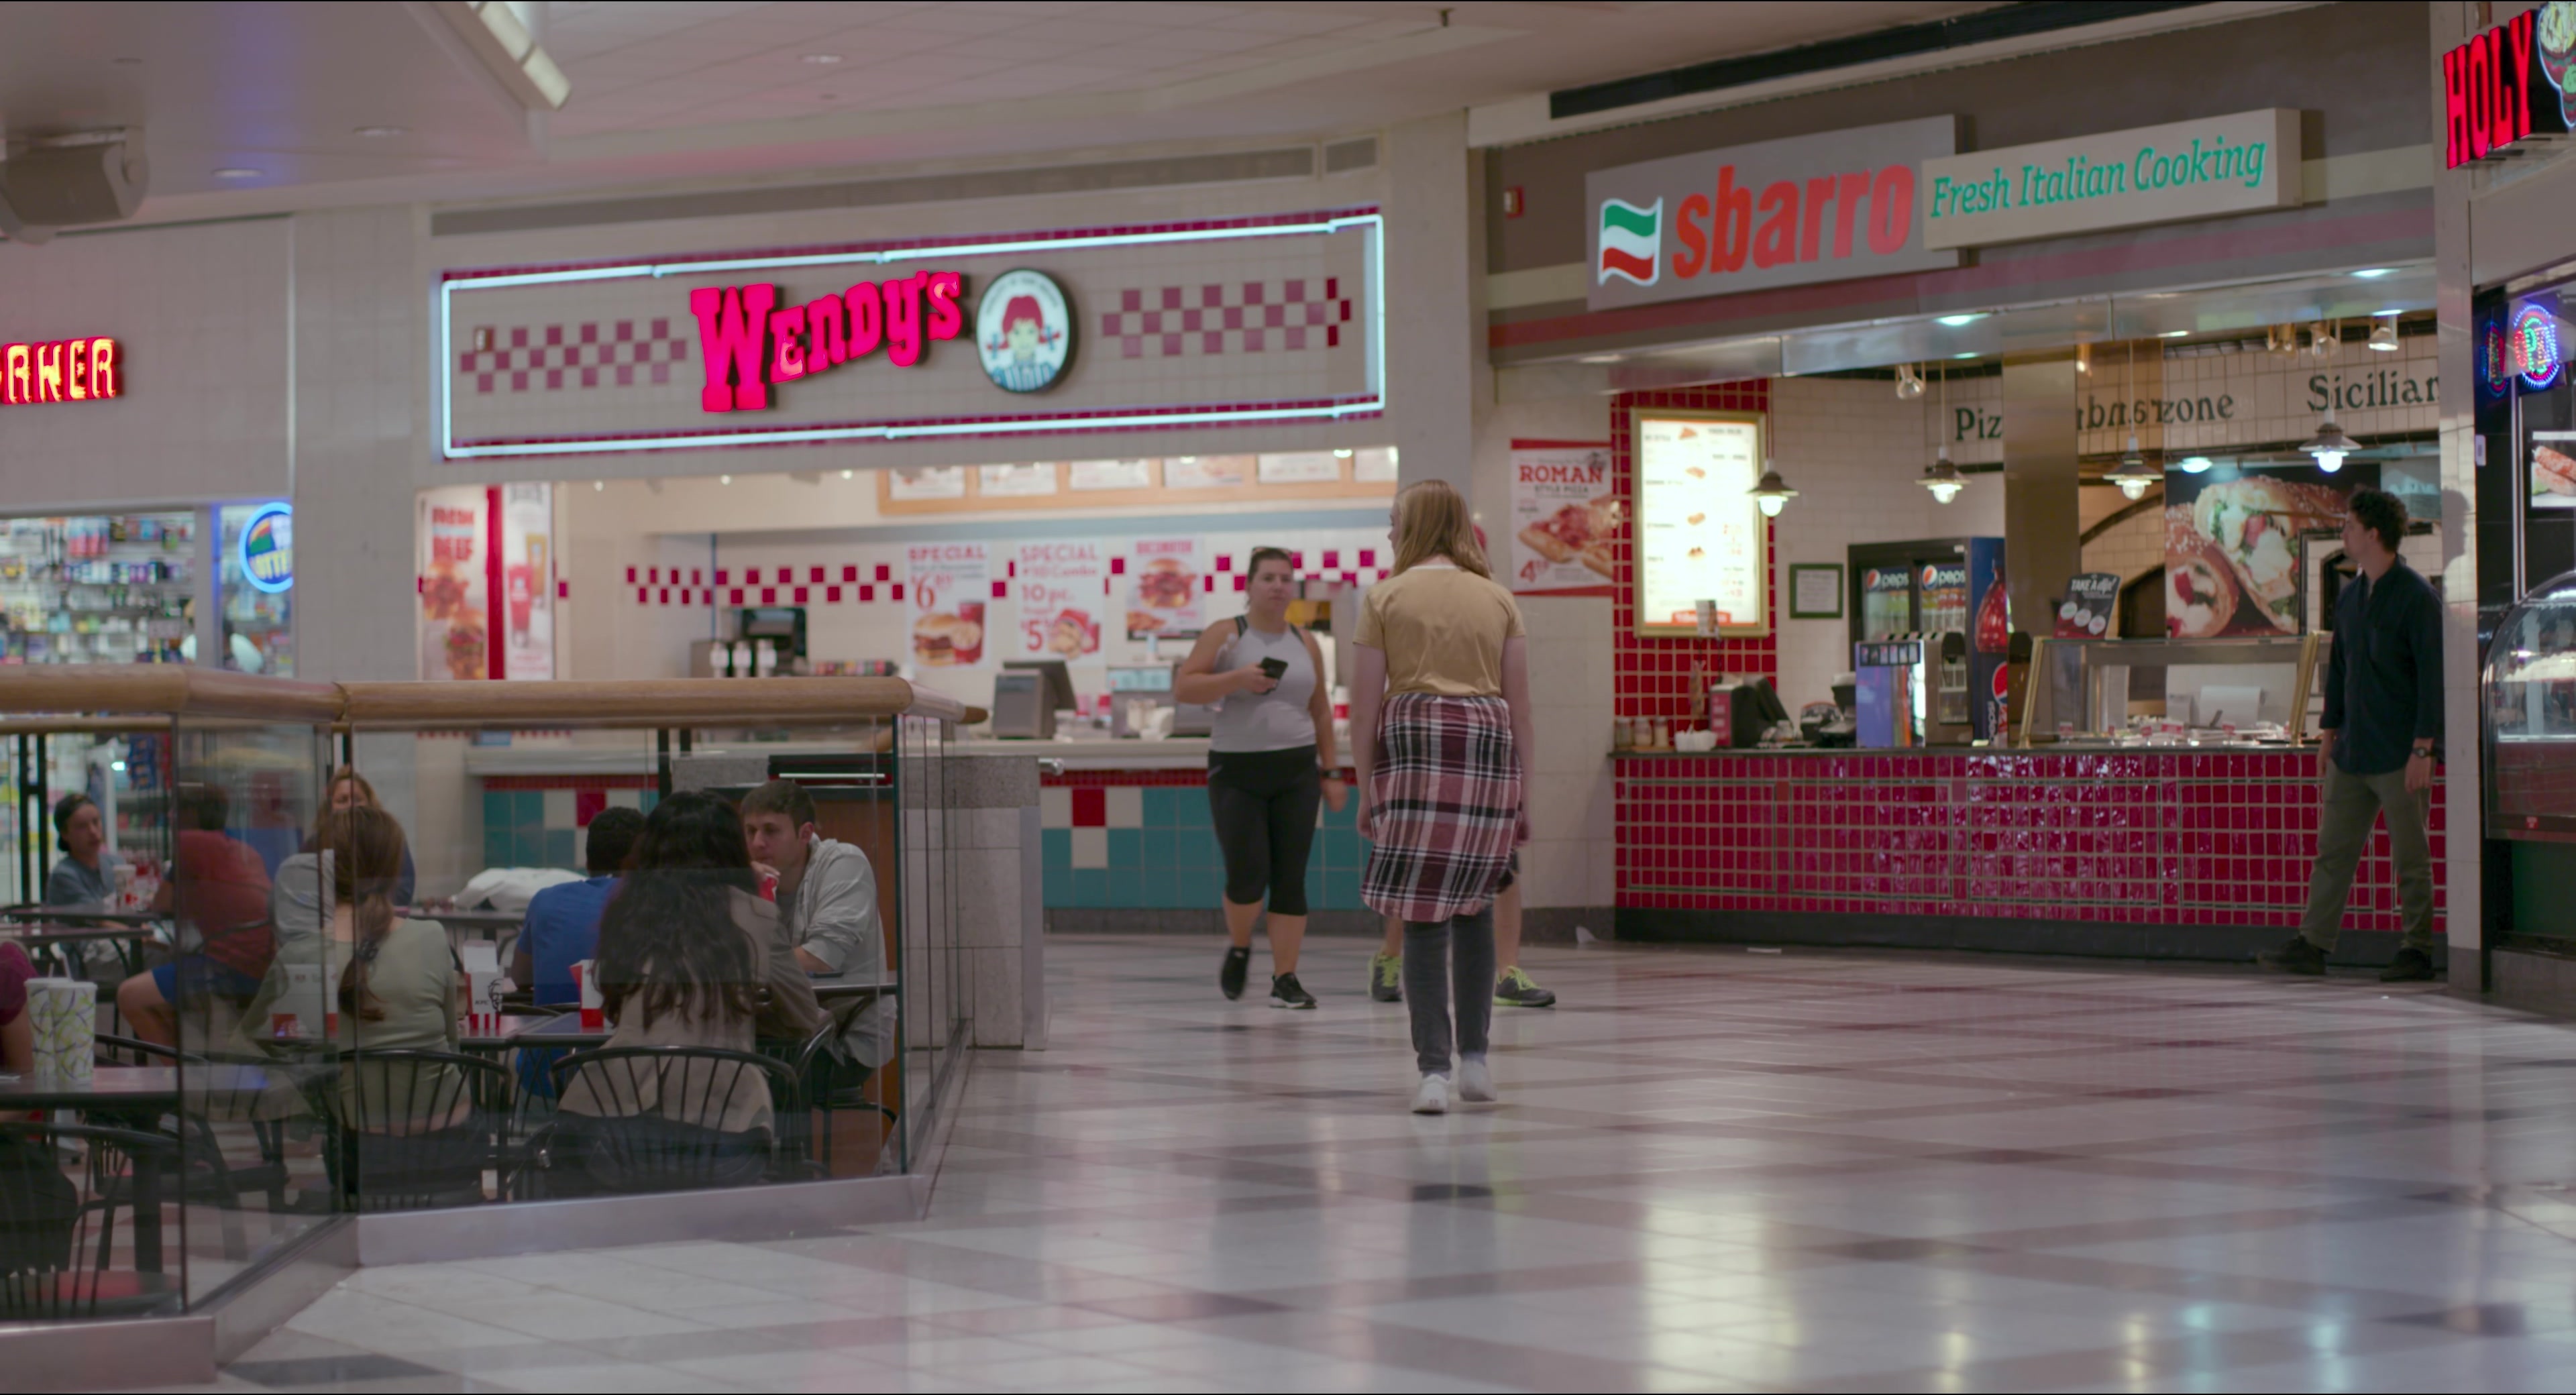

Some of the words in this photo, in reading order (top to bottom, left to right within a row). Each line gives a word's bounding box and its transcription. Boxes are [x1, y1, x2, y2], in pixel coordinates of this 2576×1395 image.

[2443, 9, 2532, 170] HOLY
[1930, 166, 2012, 218] Fresh
[2019, 154, 2127, 206] Italian
[2134, 135, 2267, 190] Cooking
[1672, 164, 1916, 280] sbarro
[0, 336, 116, 404] RNER
[2163, 394, 2235, 424] zone
[1955, 407, 2003, 441] Piz
[1519, 465, 1603, 483] ROMAN
[908, 545, 987, 562] SPECIAL
[1020, 544, 1098, 561] SPECIAL
[1881, 572, 1909, 590] peps
[1939, 569, 1966, 587] peps
[1022, 583, 1046, 602] 10
